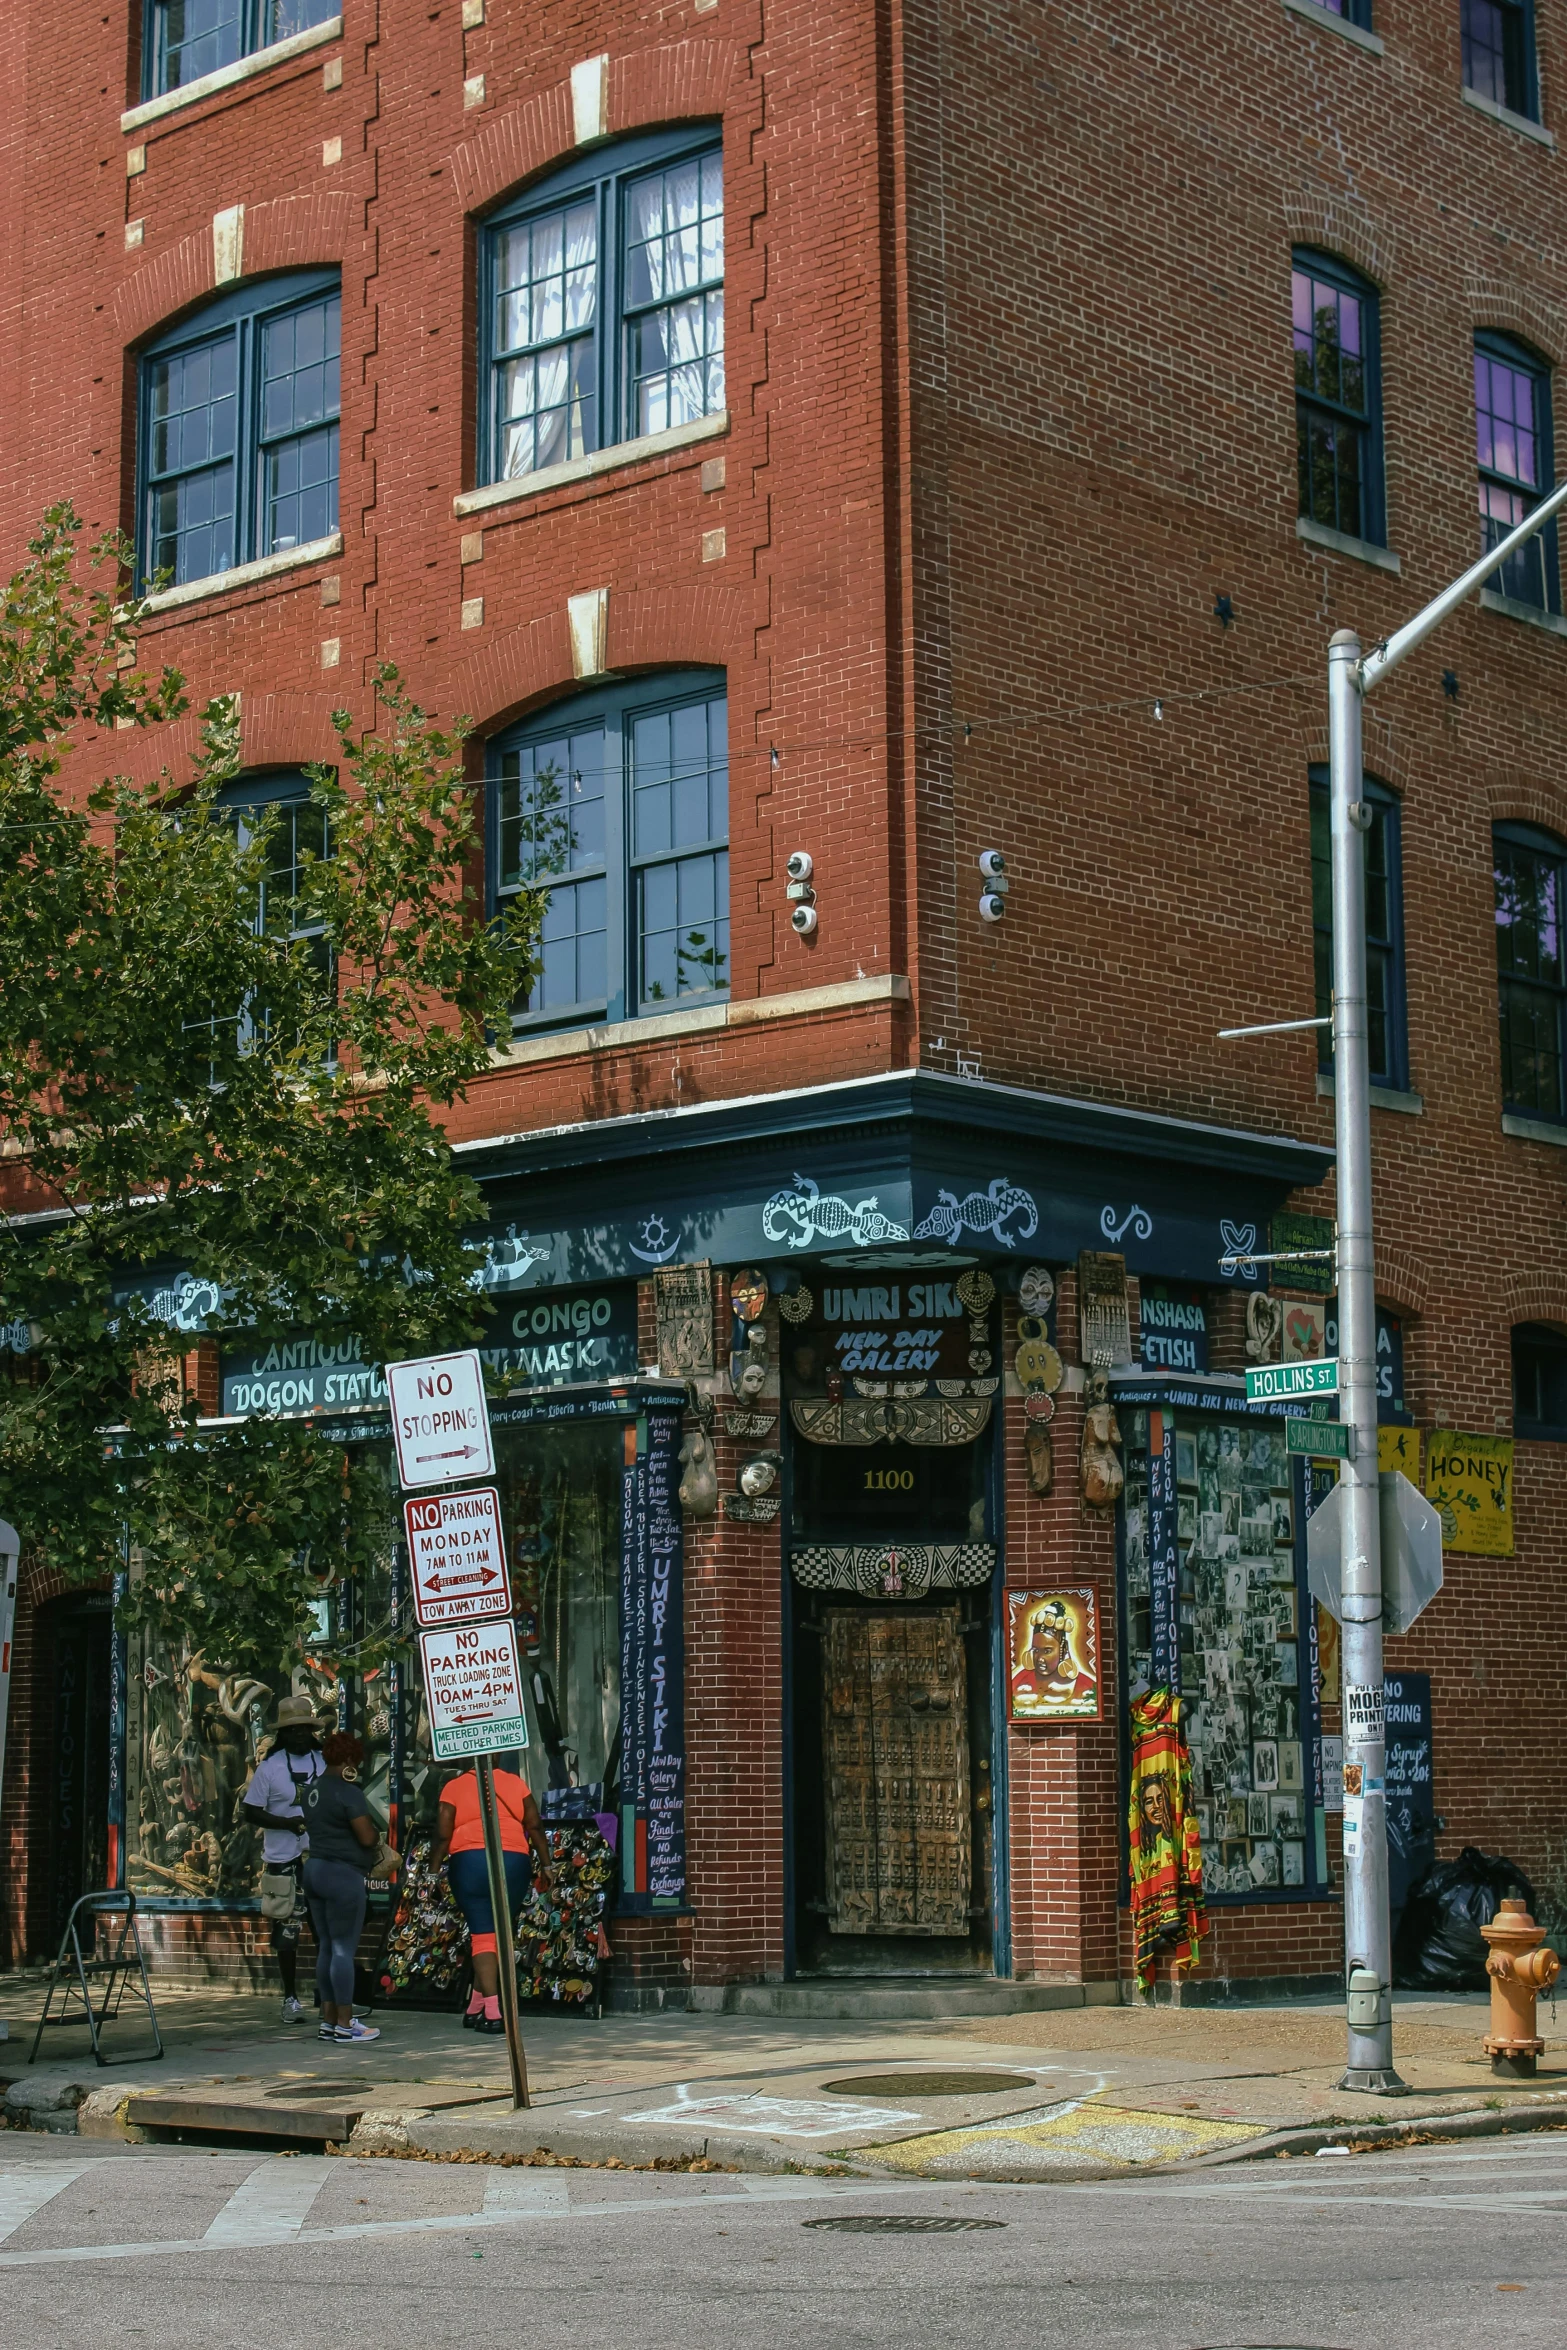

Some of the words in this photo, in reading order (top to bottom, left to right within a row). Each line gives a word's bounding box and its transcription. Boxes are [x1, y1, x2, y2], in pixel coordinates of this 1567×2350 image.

[824, 1285, 900, 1321] UMRI
[512, 1298, 612, 1338] CONGO
[834, 1331, 888, 1350] NEW
[892, 1330, 943, 1348] DAY
[502, 1339, 602, 1375] MASK
[840, 1350, 940, 1371] GALERY
[417, 1373, 453, 1399] NO
[1254, 1368, 1315, 1395] HOLLINS
[1318, 1369, 1333, 1385] ST.
[231, 1378, 314, 1414] DOGON
[548, 1404, 575, 1418] Liberia
[589, 1400, 617, 1413] Benin
[1169, 1390, 1198, 1406] UMRI
[1201, 1394, 1221, 1409] SIKI
[1225, 1397, 1247, 1411] NEW
[1269, 1403, 1304, 1416] GALERY
[402, 1407, 478, 1439] STOPPING
[864, 1470, 914, 1489] 1100
[1152, 1461, 1161, 1497] NEW
[1163, 1432, 1173, 1503] DOGON
[1431, 1455, 1508, 1490] HONEY
[637, 1468, 646, 1505] SHEA
[411, 1503, 439, 1529] NO
[442, 1498, 493, 1522] PARKING
[624, 1478, 632, 1530] DOGON
[421, 1528, 491, 1552] MONDAY
[637, 1512, 646, 1574] BUTTER
[426, 1556, 446, 1570] 7AM
[449, 1554, 462, 1566] TO
[466, 1550, 489, 1564] 11AM
[432, 1578, 454, 1588] STREET
[457, 1573, 488, 1584] CLEANING
[623, 1554, 632, 1610] BAULE
[423, 1604, 444, 1618] TOW
[448, 1600, 476, 1615] AWAY
[479, 1595, 505, 1610] ZONE
[637, 1585, 646, 1637] SOAPS
[650, 1559, 671, 1646] UMRI
[456, 1631, 479, 1650] NO
[430, 1647, 510, 1673] PARKING
[432, 1674, 457, 1688] TRUCK
[459, 1668, 490, 1684] LOADING
[492, 1665, 512, 1679] ZONE
[1384, 1680, 1403, 1698] NO
[434, 1681, 514, 1705] 10AM-4PM
[444, 1705, 467, 1714] TUES
[468, 1701, 490, 1712] THRU
[492, 1698, 508, 1707] SAT
[651, 1655, 669, 1752] SIKI
[438, 1727, 479, 1742] METERED
[482, 1721, 521, 1737] PARKING
[623, 1701, 632, 1773] SENUFO
[1367, 1724, 1377, 1733] ON
[441, 1742, 460, 1754] ALL
[462, 1736, 492, 1750] OTHER
[494, 1732, 521, 1746] TIMES
[1324, 1746, 1334, 1757] NO
[636, 1748, 646, 1800] OILS
[667, 1754, 682, 1770] Day
[1312, 1742, 1321, 1797] KUBA
[650, 1770, 677, 1788] Galery
[663, 1796, 684, 1809] Sales
[648, 1819, 675, 1839] Final
[657, 1843, 670, 1853] NO
